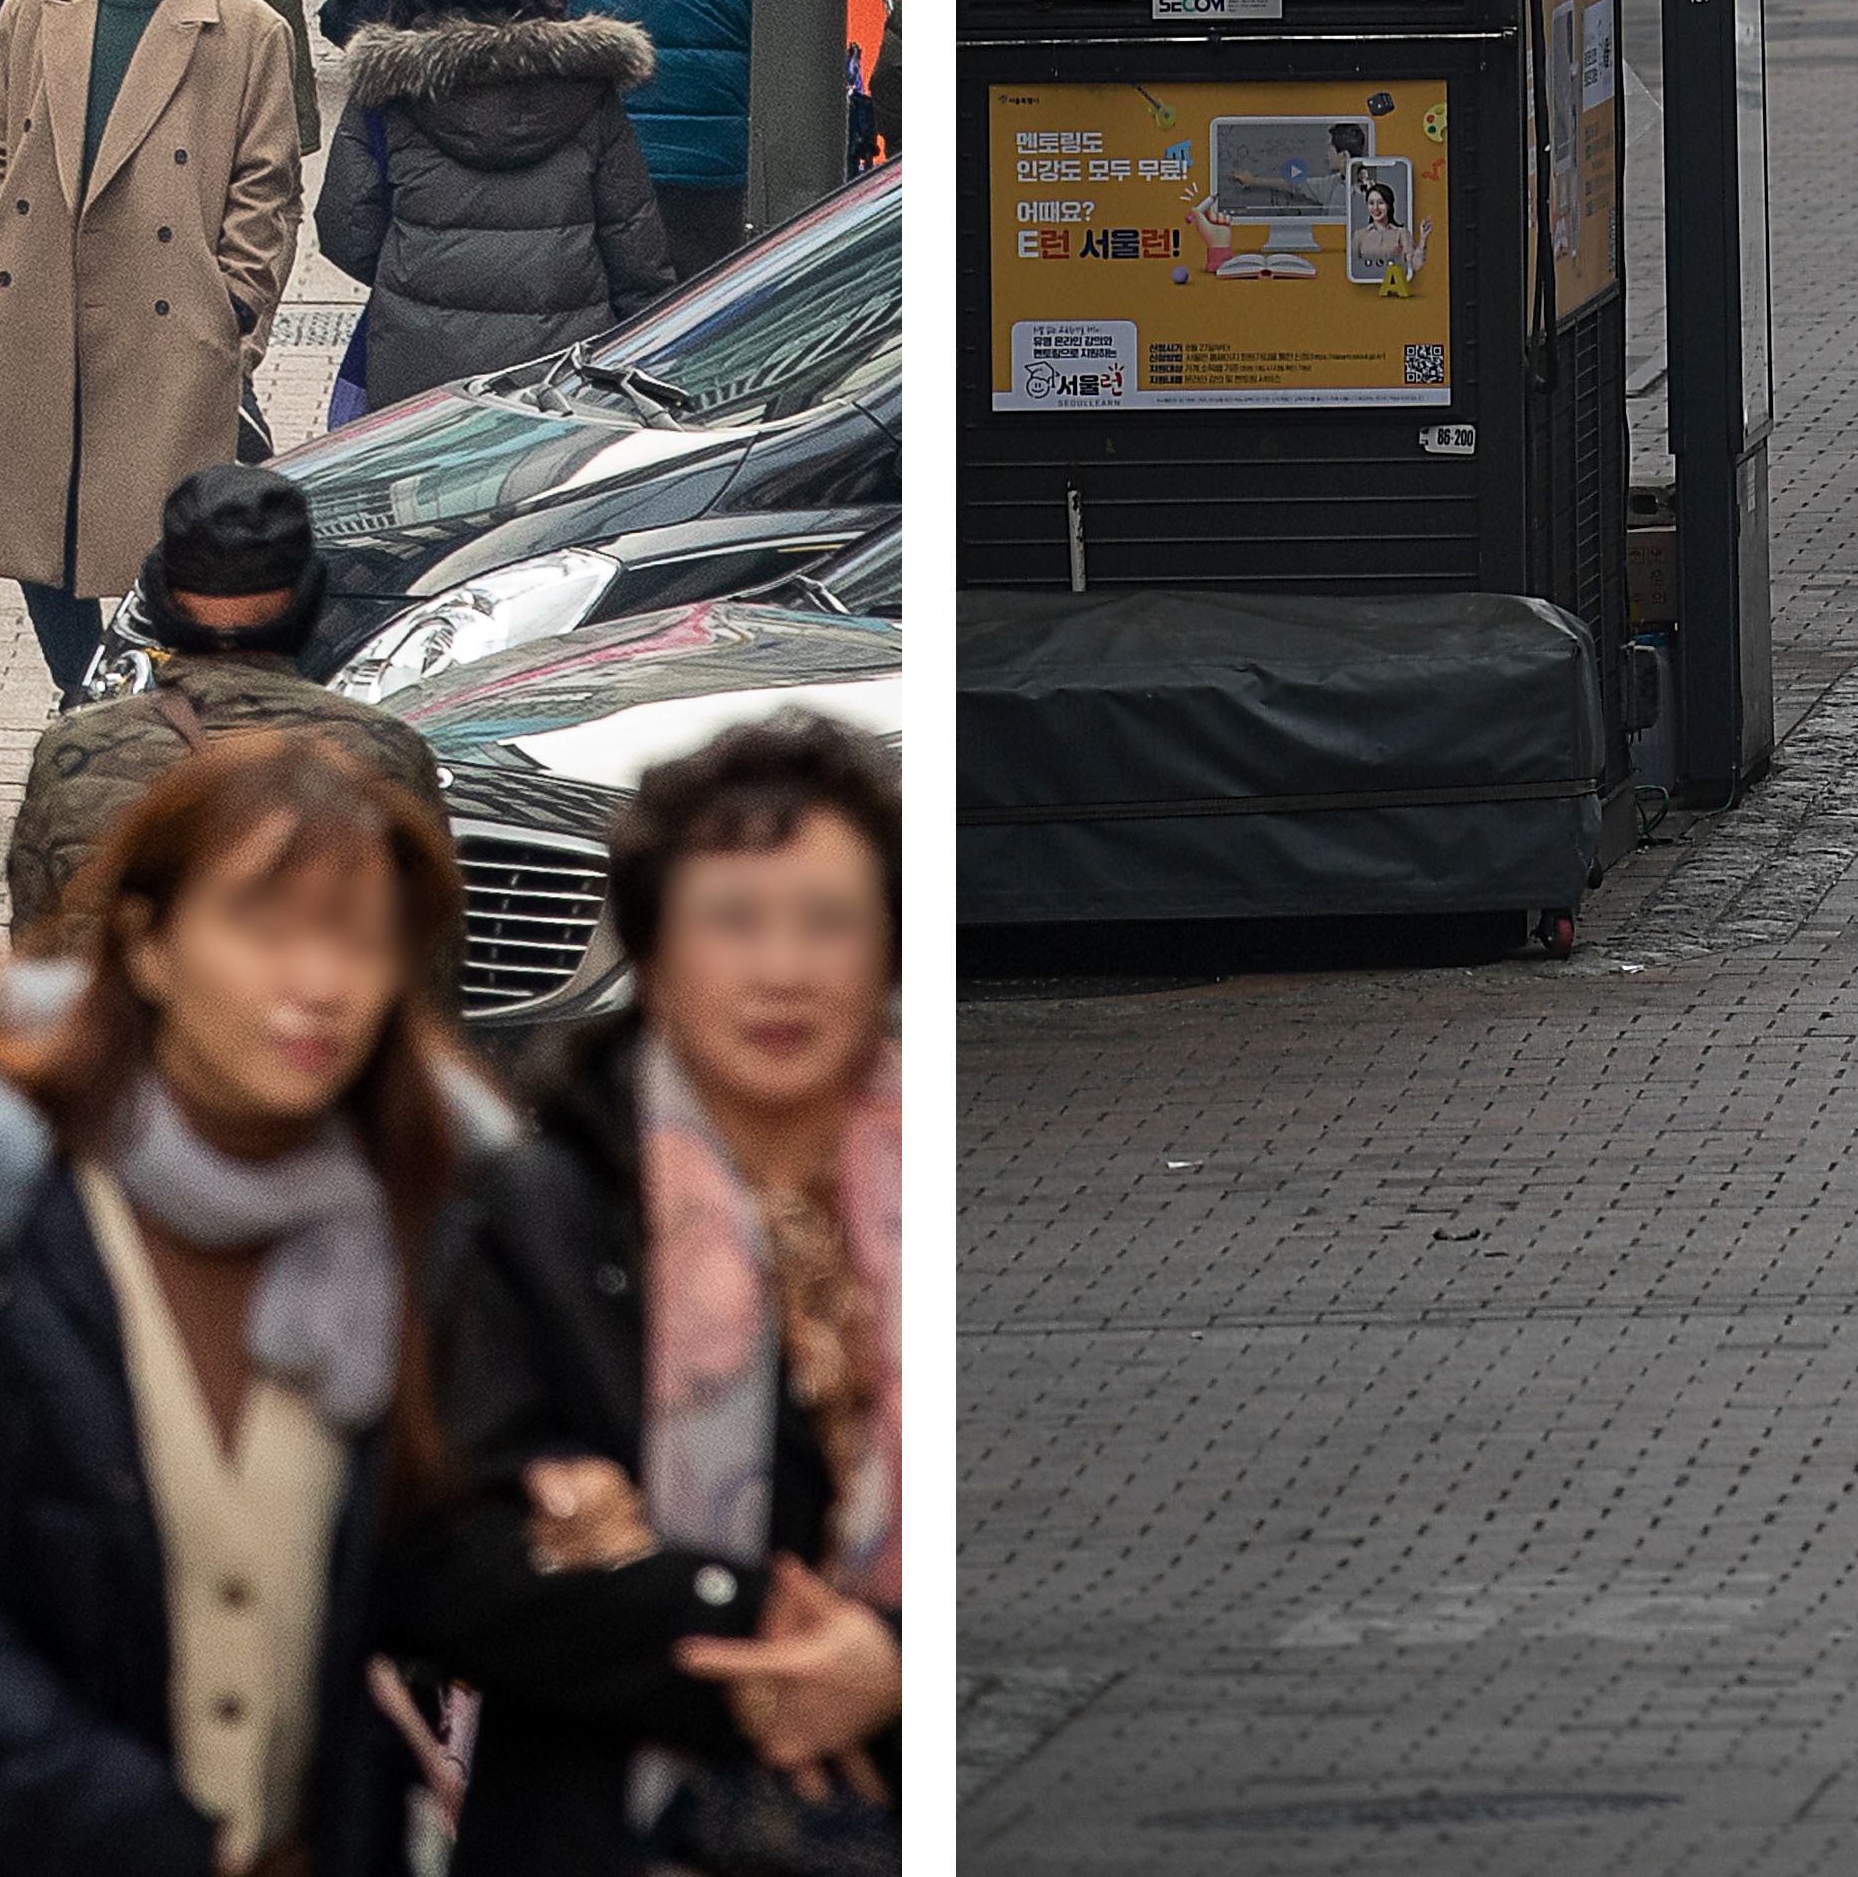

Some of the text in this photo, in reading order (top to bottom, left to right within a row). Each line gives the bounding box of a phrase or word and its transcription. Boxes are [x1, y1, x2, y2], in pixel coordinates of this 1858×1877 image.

[1016, 131, 1104, 155] 멘토링도
[1016, 158, 1189, 182] 인강도 모두 무료!
[1016, 200, 1096, 224] 어때요?
[1017, 228, 1181, 260] E런 서울런!
[1054, 335, 1083, 347] 온라인
[1056, 370, 1124, 398] 서울런
[1437, 427, 1474, 447] 86-200
